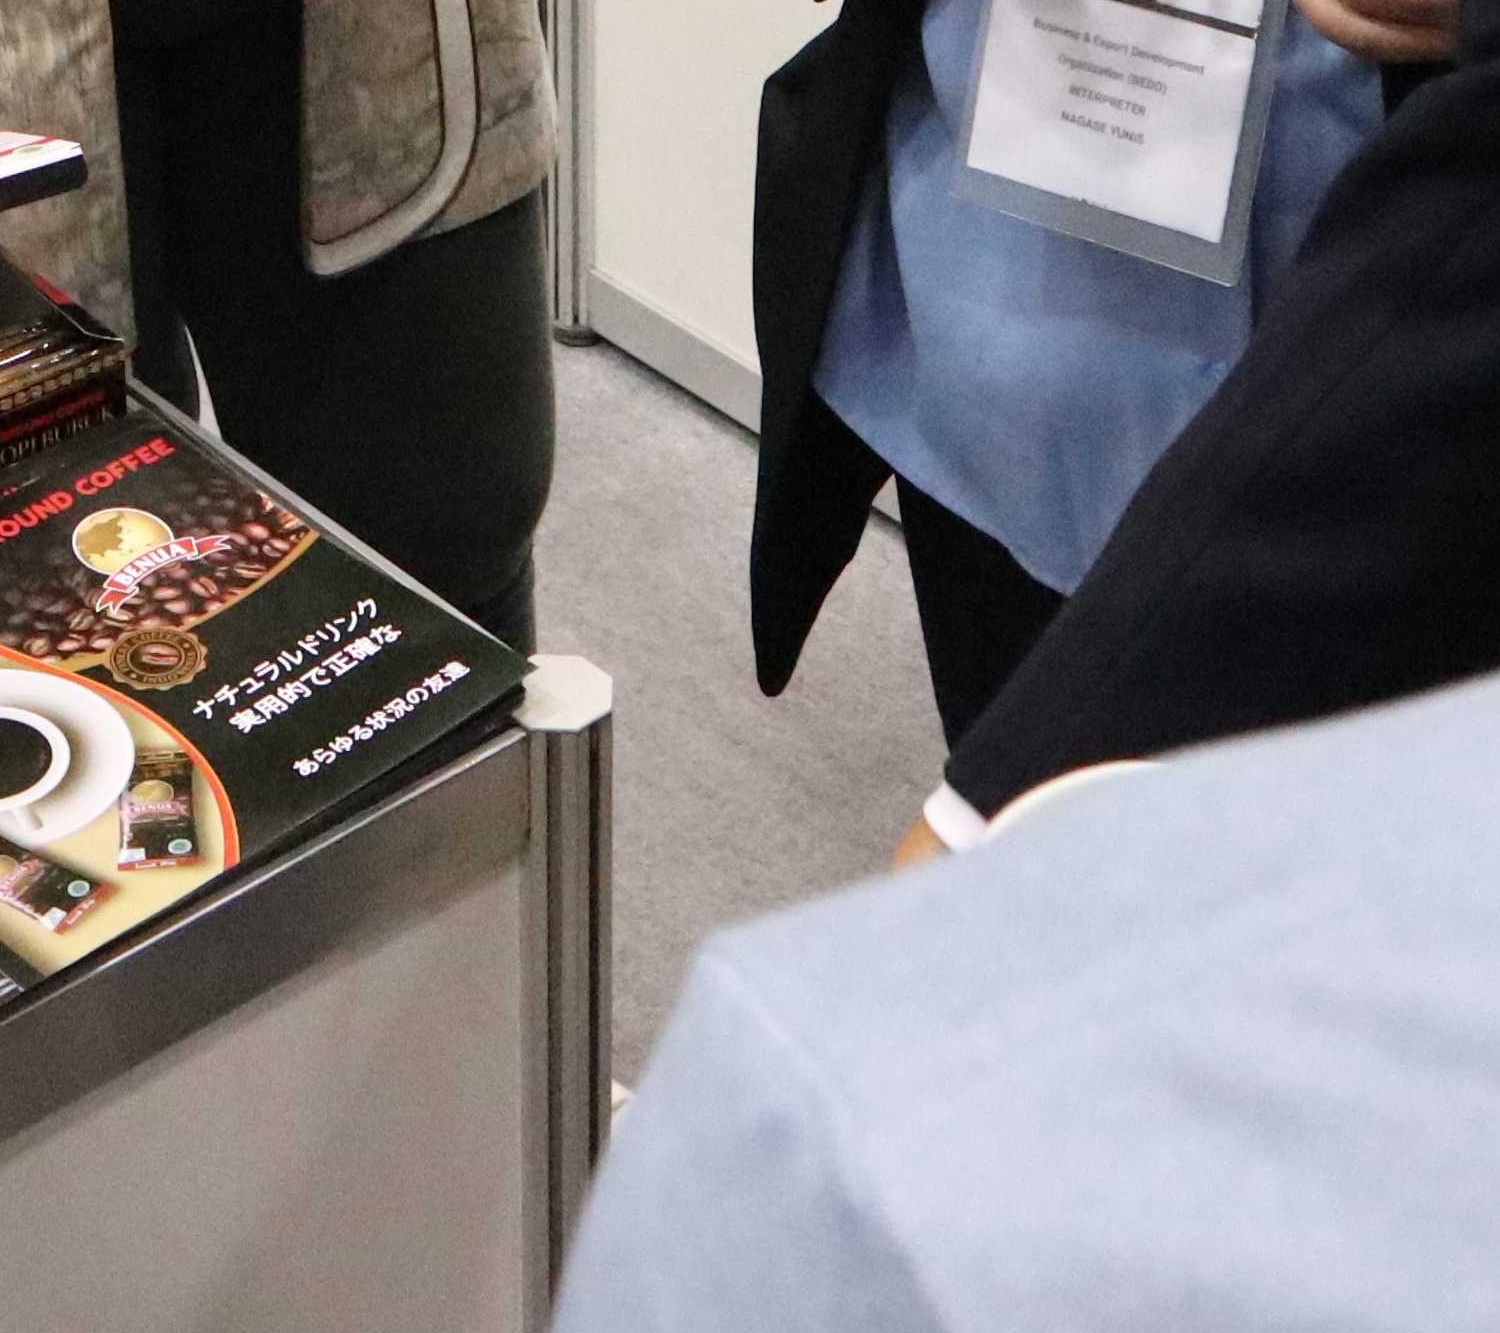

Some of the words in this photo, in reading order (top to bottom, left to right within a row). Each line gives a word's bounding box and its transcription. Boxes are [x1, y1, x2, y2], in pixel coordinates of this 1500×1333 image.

[1093, 35, 1129, 55] Export
[1131, 46, 1205, 76] Development
[1061, 110, 1107, 133] NAGASE
[1069, 83, 1146, 116] INTERPRETER
[73, 436, 178, 496] COFFEE
[113, 543, 187, 587] BENUA
[192, 597, 378, 720] ナチュラルドリンク
[229, 624, 403, 734] 実用的で正確な
[293, 661, 471, 777] あらゆる状況の友達
